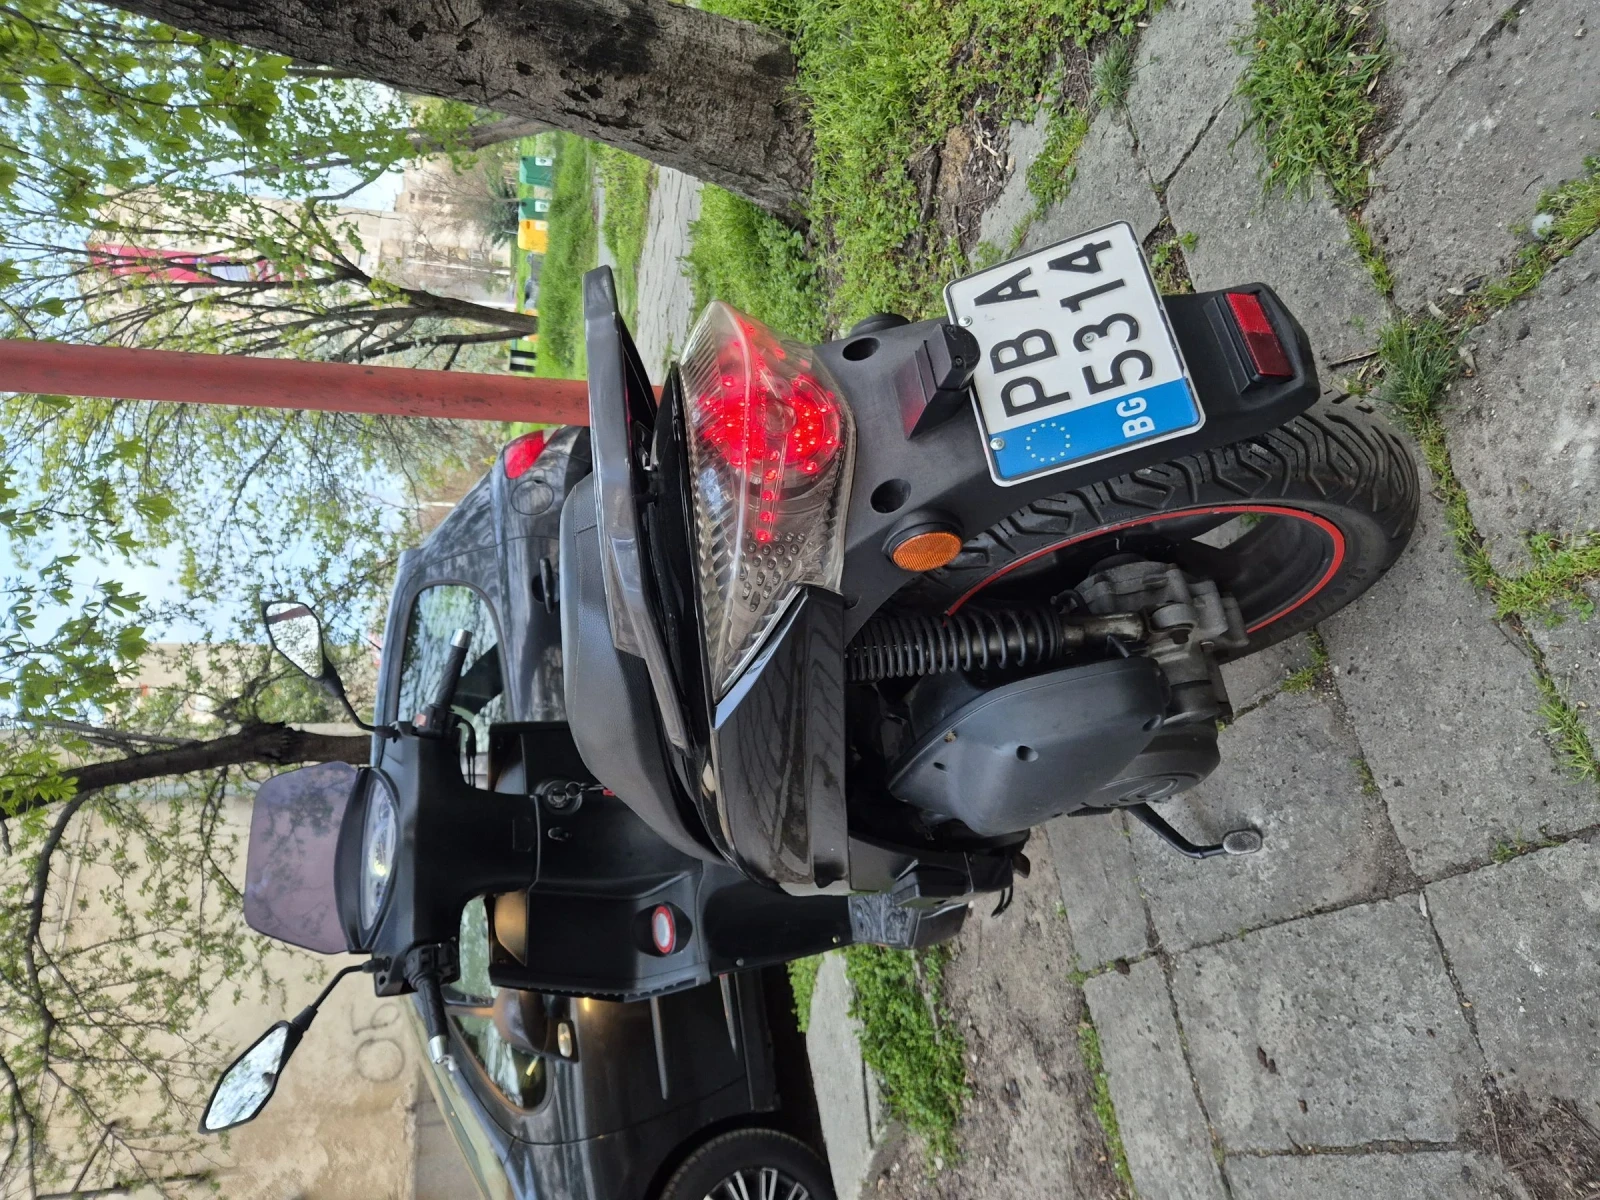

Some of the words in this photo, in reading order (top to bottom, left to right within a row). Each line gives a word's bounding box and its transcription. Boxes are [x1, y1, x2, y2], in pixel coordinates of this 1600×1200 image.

[973, 266, 1039, 307] A
[1047, 239, 1156, 395] 5314
[990, 328, 1072, 418] PB
[1115, 396, 1156, 438] BG
